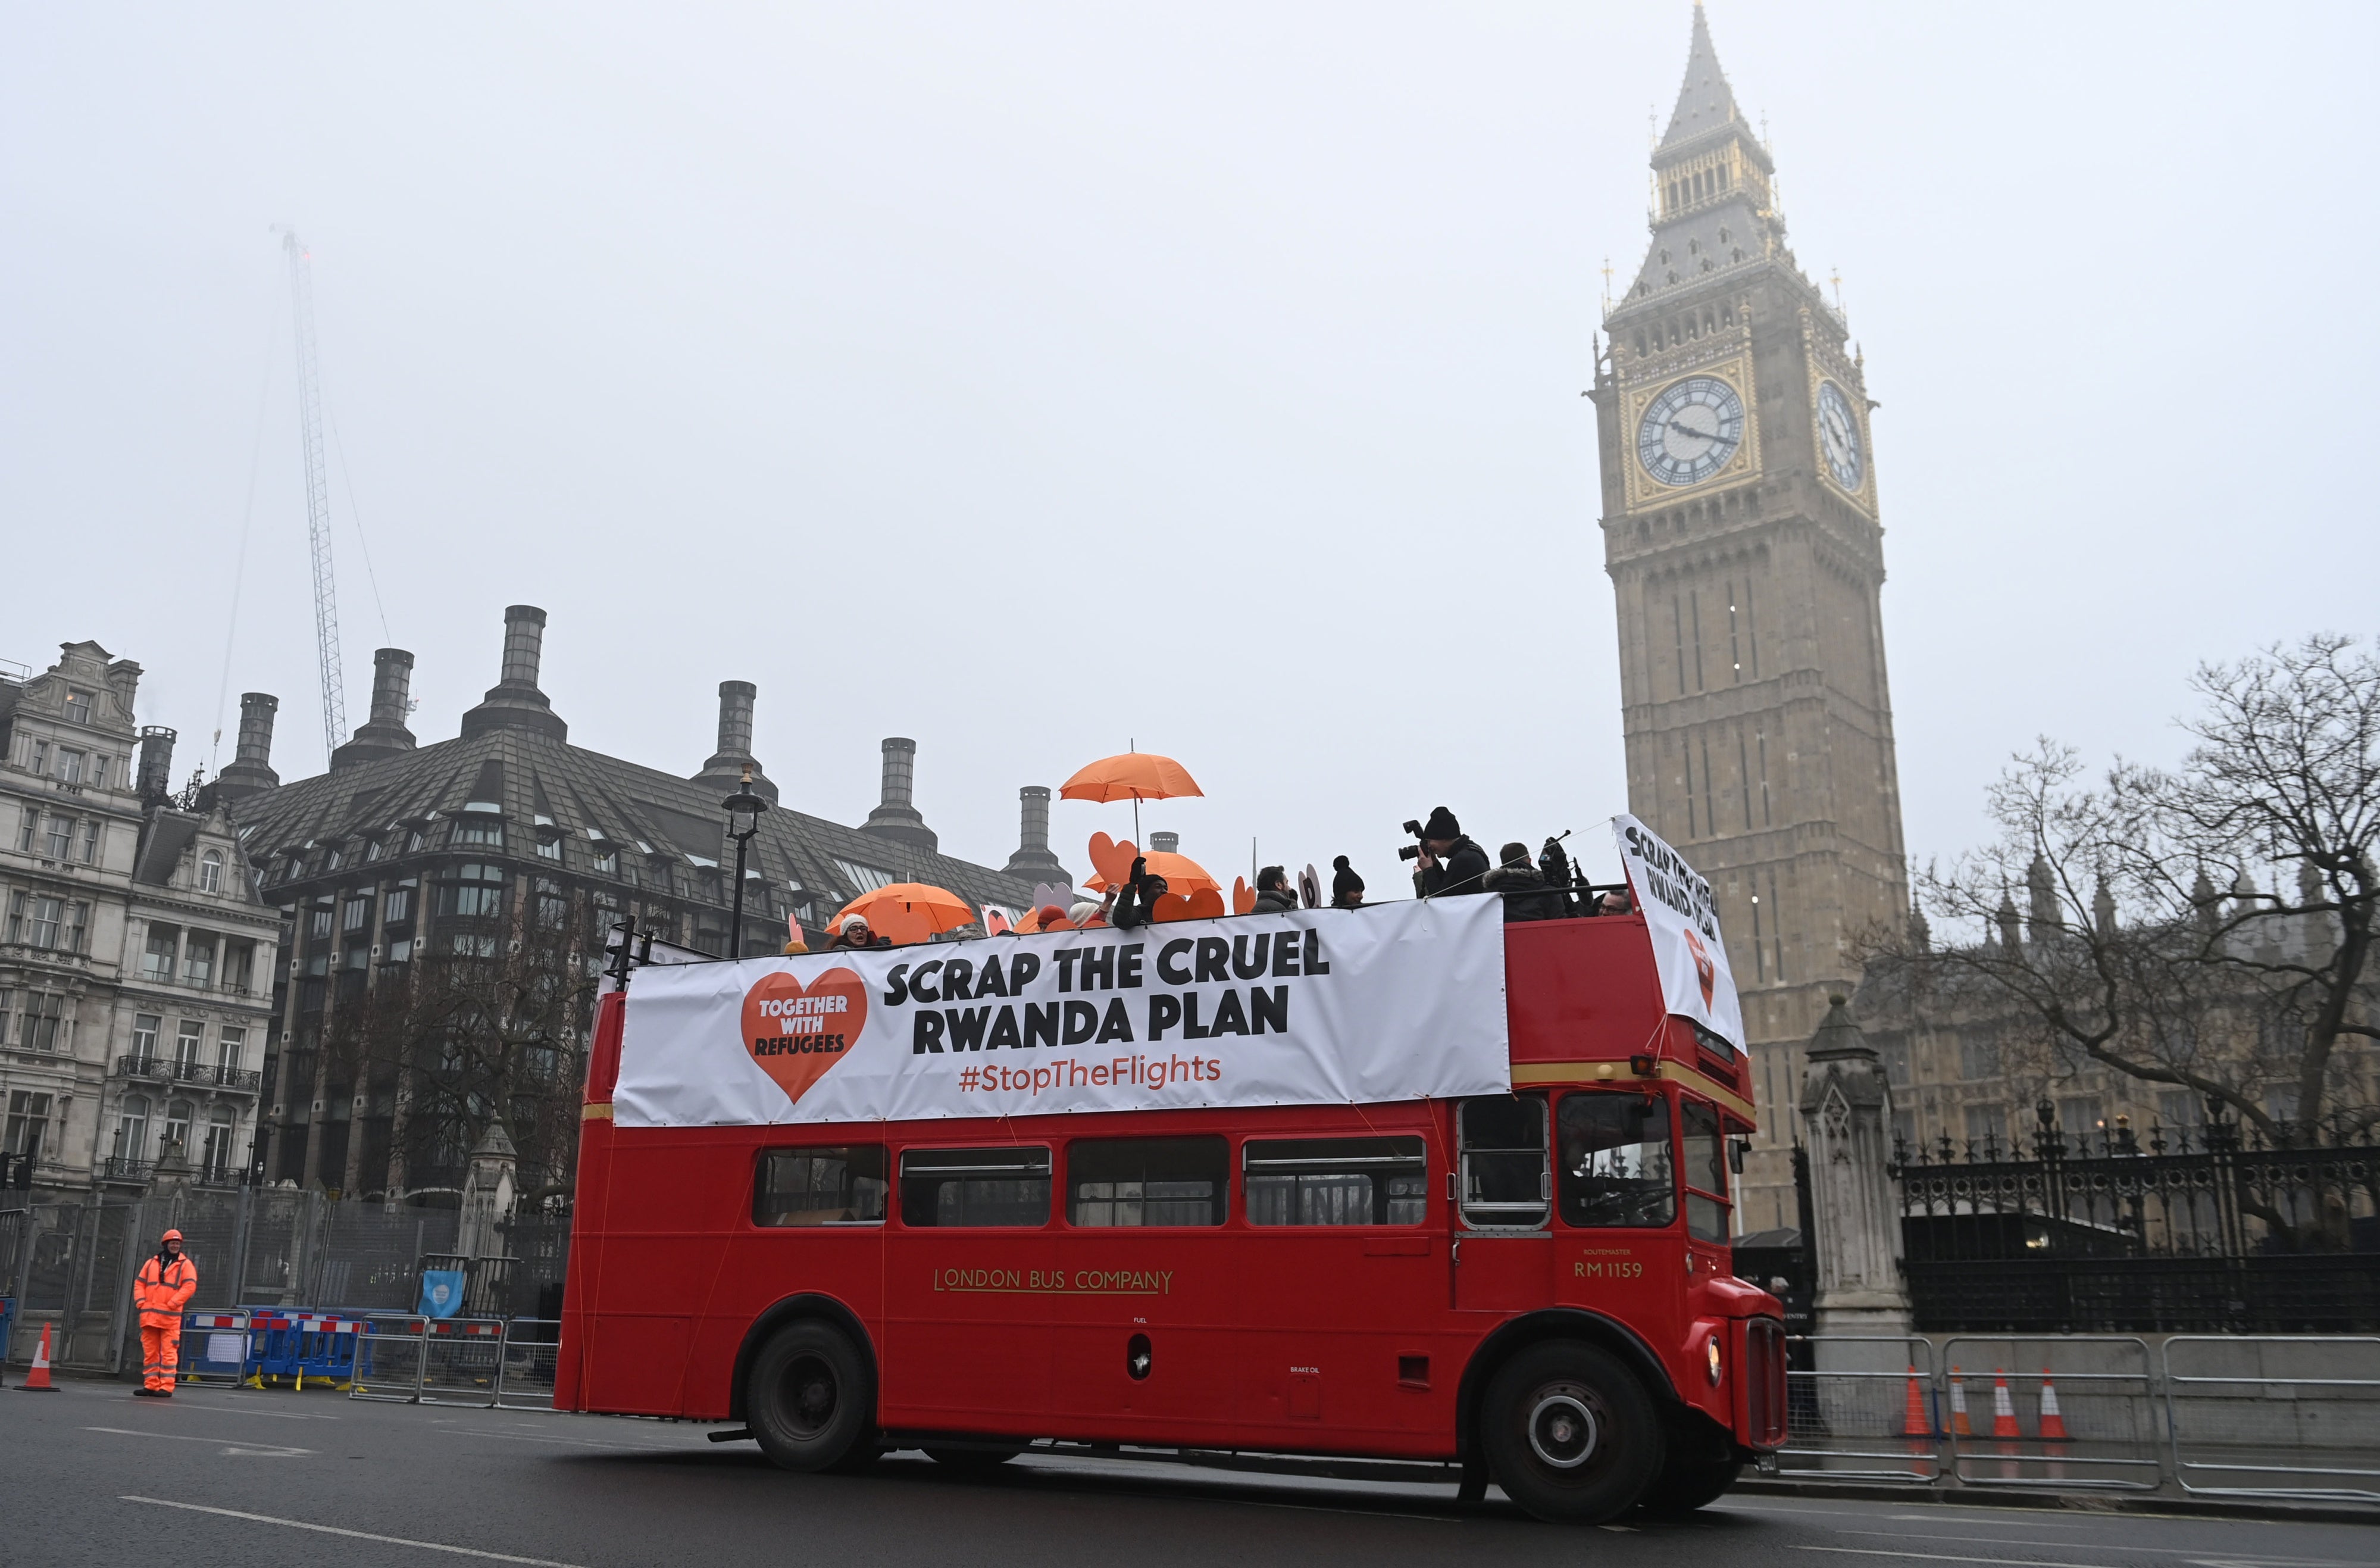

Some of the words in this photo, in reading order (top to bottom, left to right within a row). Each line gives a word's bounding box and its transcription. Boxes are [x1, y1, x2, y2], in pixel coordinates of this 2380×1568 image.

[1625, 826, 1670, 876] SCRAP
[1646, 866, 1695, 921] RWAND
[884, 952, 1041, 1006] SCRAP
[1053, 943, 1145, 993] THE
[1156, 928, 1330, 985] CRUEL
[759, 995, 847, 1017] TOGETHER
[913, 997, 1134, 1054] RWANDA
[1147, 985, 1289, 1042] PLAN
[780, 1016, 824, 1035] WITH
[754, 1034, 845, 1056] REFUGEES
[958, 1054, 1221, 1096] #StopTheFlights
[934, 1269, 1021, 1291] LONDON
[1030, 1270, 1065, 1289] BUS
[1075, 1270, 1174, 1295] COMPANY
[1575, 1262, 1602, 1277] RM
[1607, 1263, 1643, 1278] 1159
